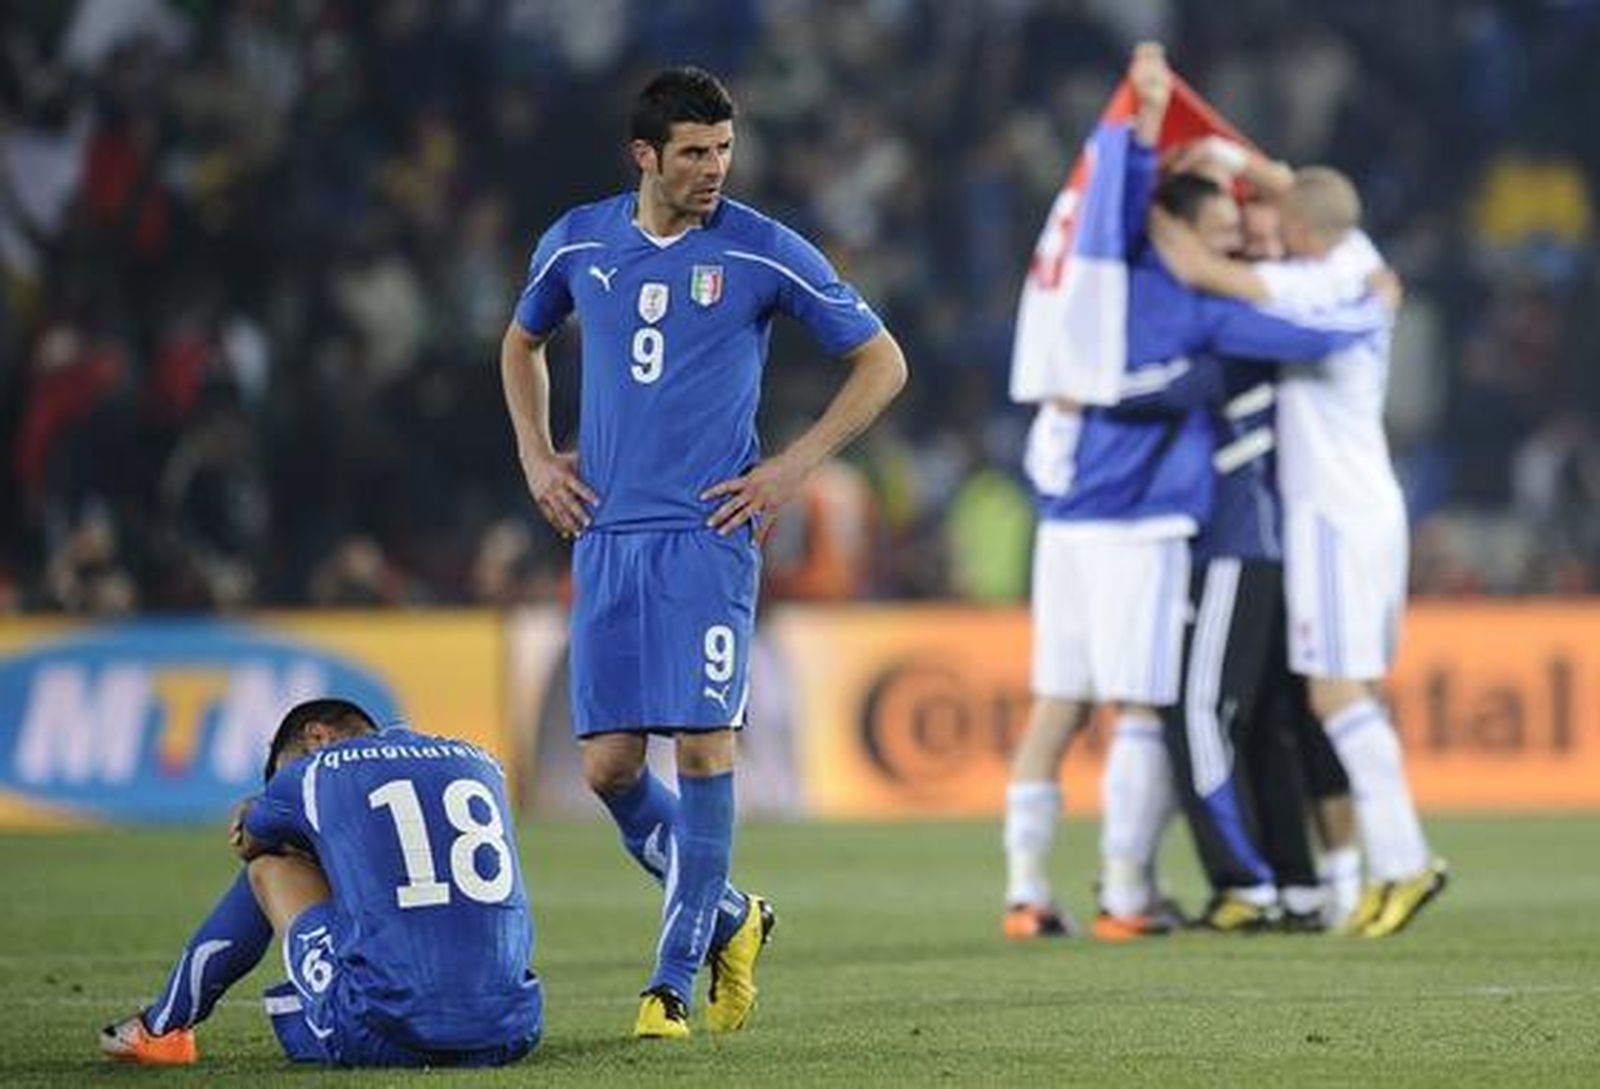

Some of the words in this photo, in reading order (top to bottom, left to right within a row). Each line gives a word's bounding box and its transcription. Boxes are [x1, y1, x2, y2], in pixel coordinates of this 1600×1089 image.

[632, 327, 664, 384] 9
[704, 625, 735, 682] 9
[368, 779, 513, 908] 18
